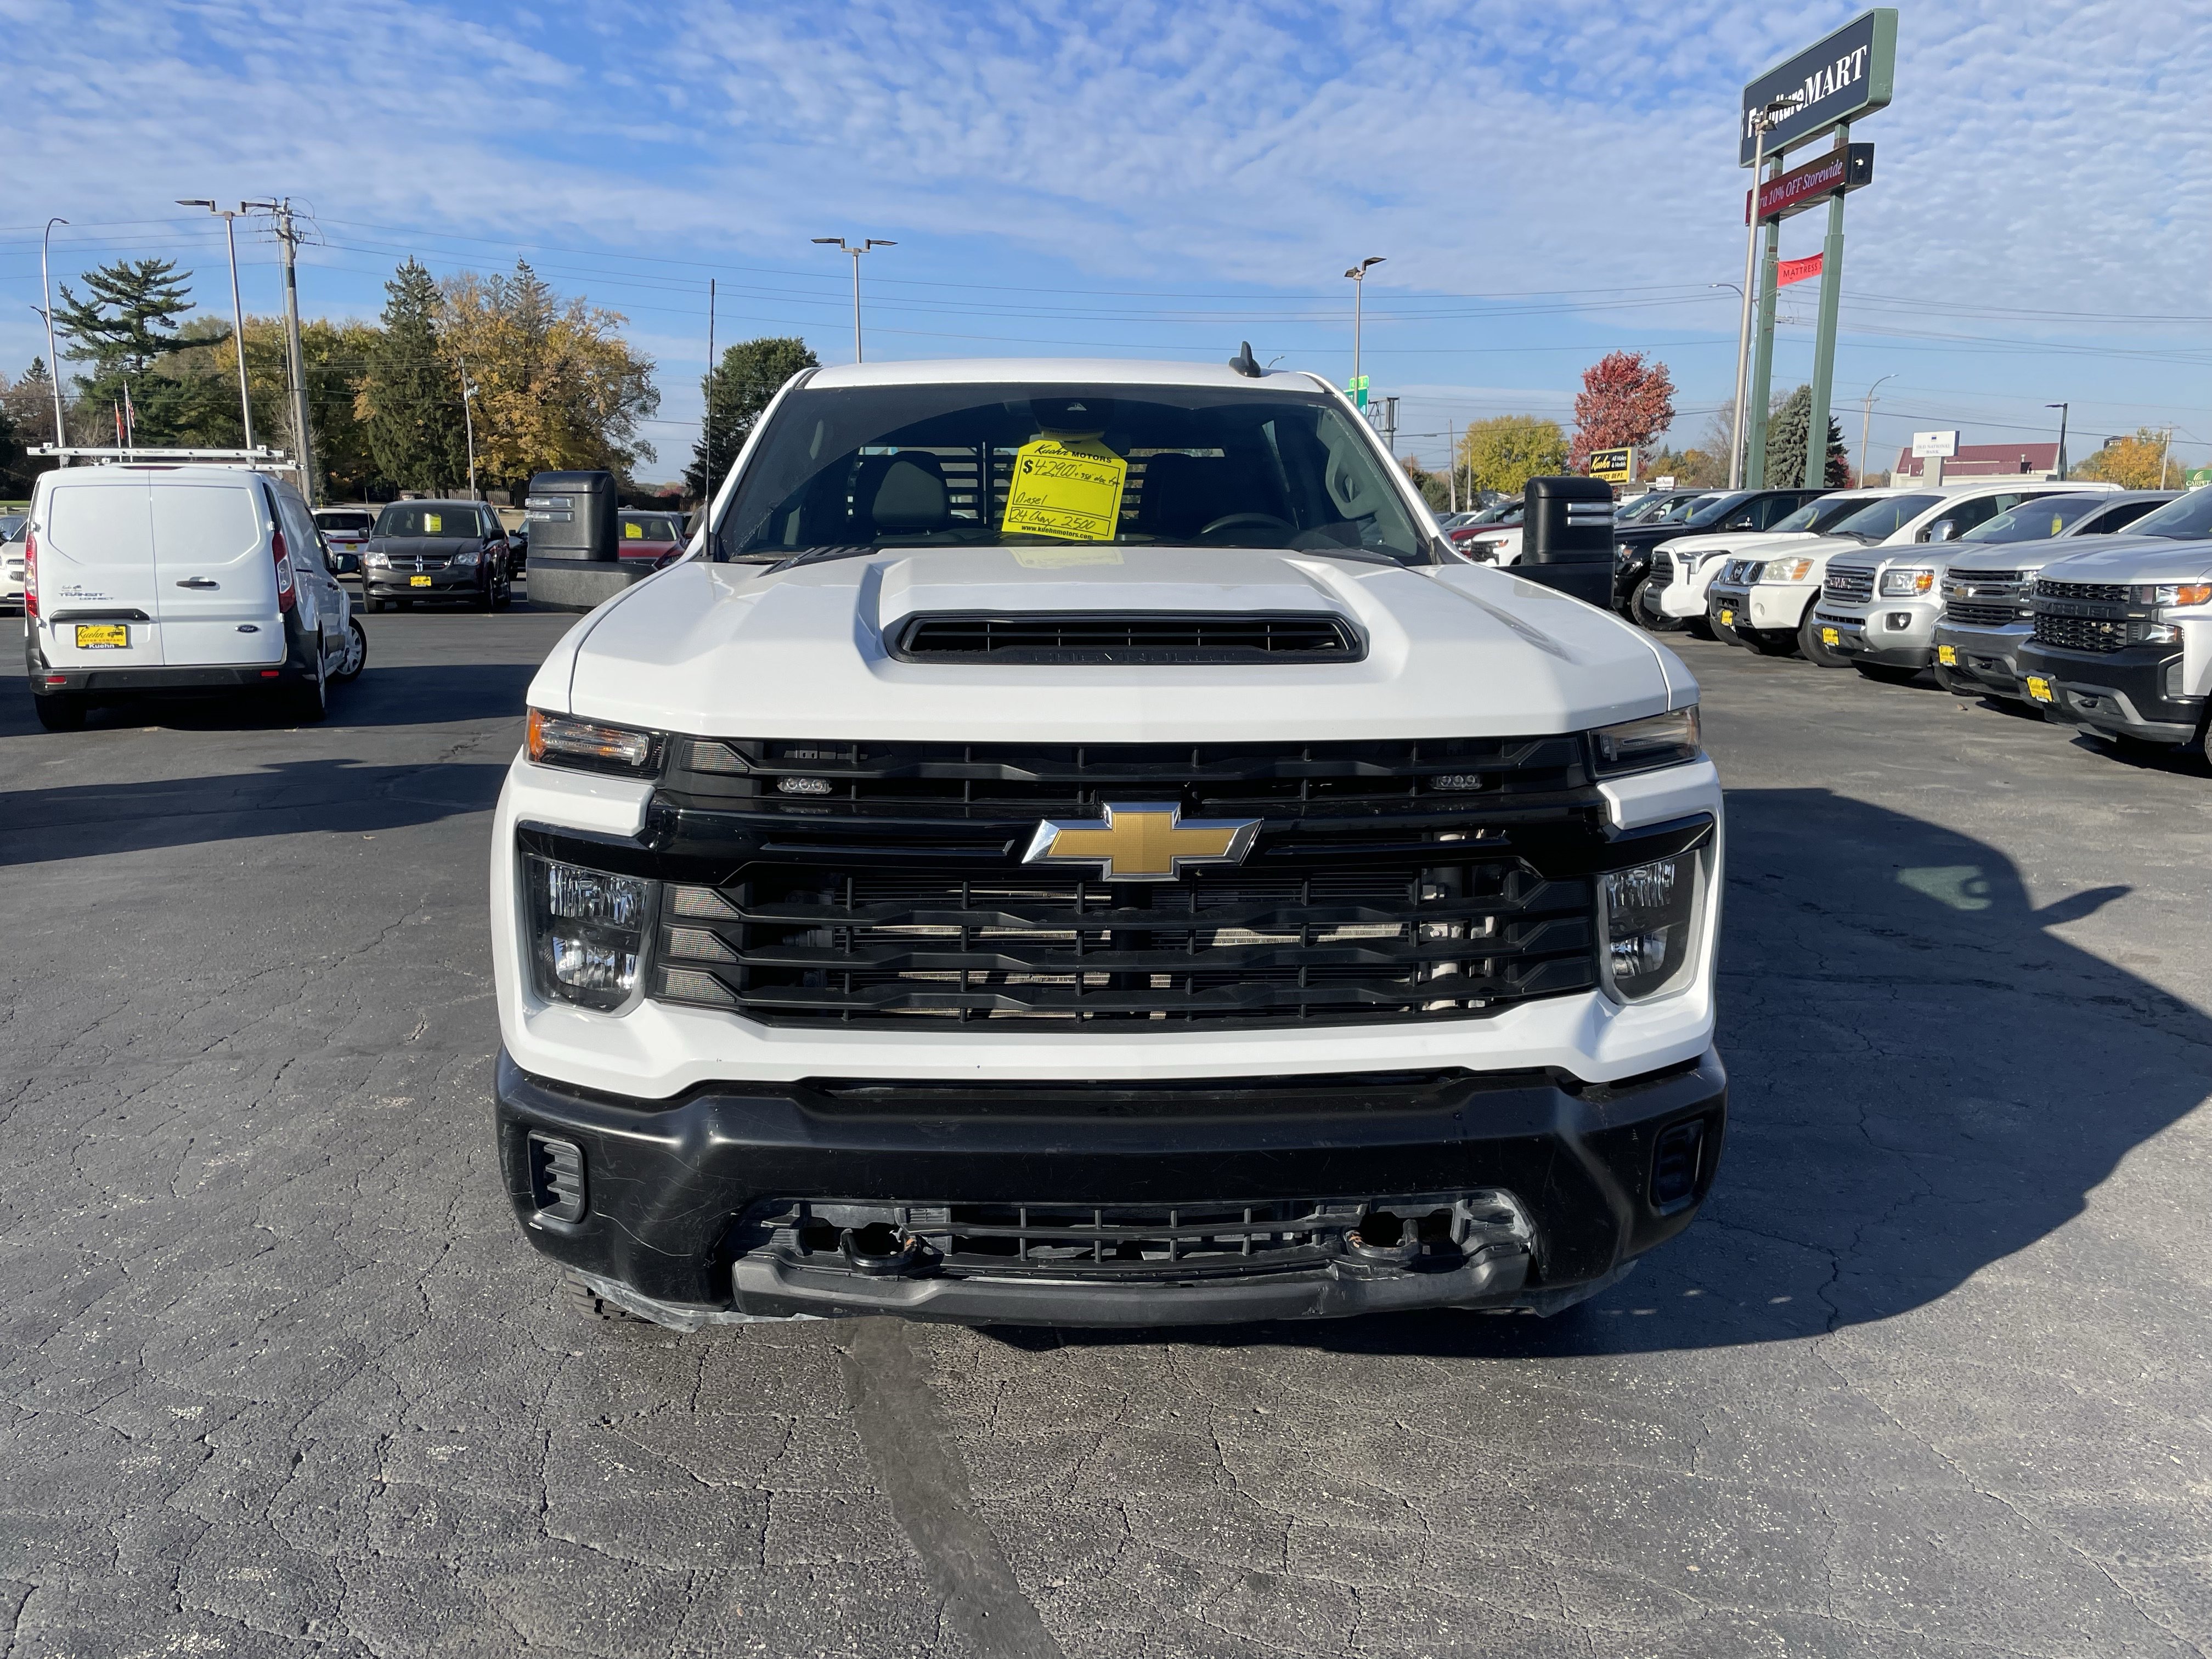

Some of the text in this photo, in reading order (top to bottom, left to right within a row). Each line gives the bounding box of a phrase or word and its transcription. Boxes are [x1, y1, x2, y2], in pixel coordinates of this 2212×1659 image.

[1769, 185, 1783, 205] 10%
[1786, 176, 1802, 198] OFF
[1803, 159, 1843, 190] Storewide
[1783, 263, 1818, 278] MATTRESS
[1034, 444, 1112, 464] Kuehn MOTORS
[1591, 454, 1610, 471] Kuehn
[1015, 492, 1048, 505] Diesel
[1061, 516, 1096, 530] 2500
[1022, 525, 1093, 540] www.kuehnmotors.com
[77, 628, 104, 640] Kuehn
